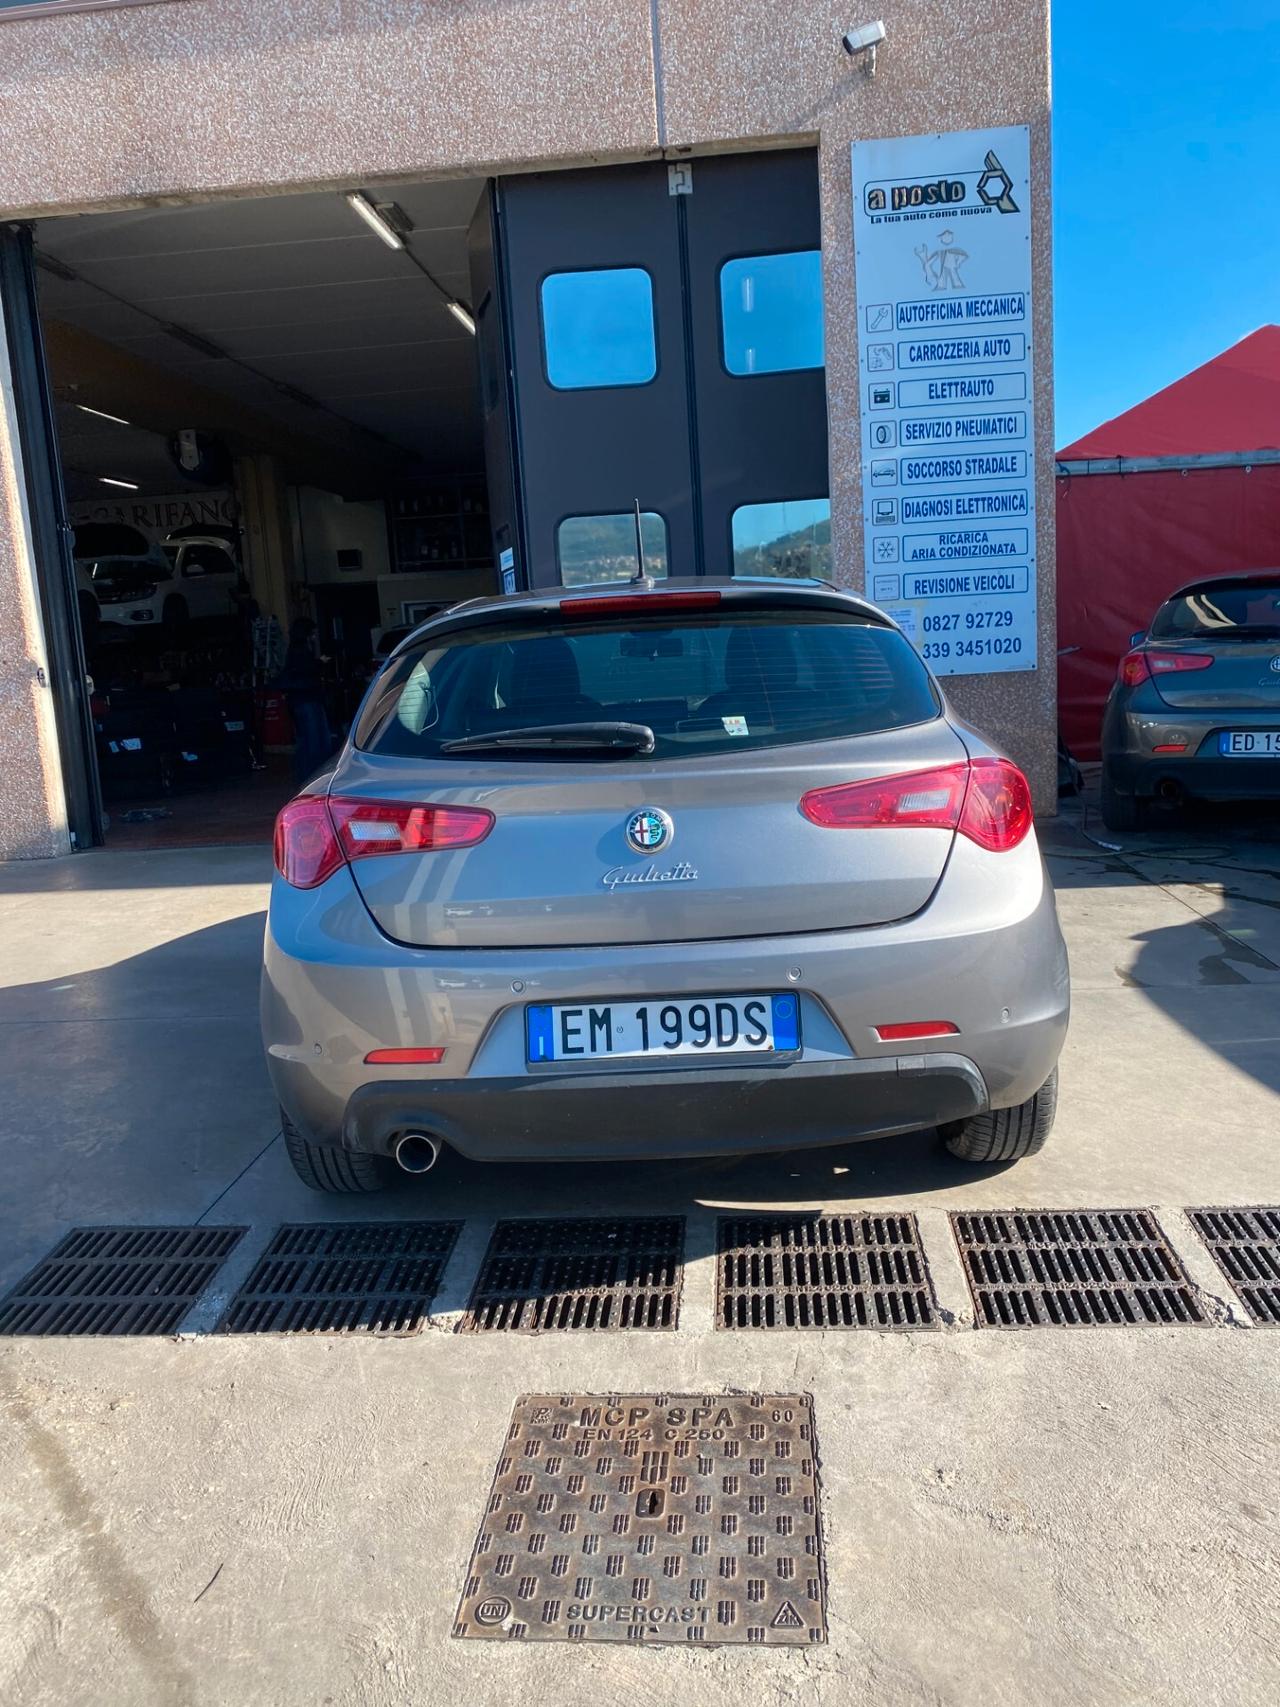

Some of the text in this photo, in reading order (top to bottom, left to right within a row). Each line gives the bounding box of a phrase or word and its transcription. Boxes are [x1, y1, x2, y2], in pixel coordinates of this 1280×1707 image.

[868, 180, 966, 211] a posto
[871, 207, 992, 224] La tua auto come nuova
[899, 297, 1024, 323] AUTOFFICINA MECCANICA
[909, 338, 1011, 362] CARROZZERIA AUTO
[928, 379, 994, 400] ELETTRAUTO
[905, 416, 1017, 440] SERVIZIO PNEUMATICI
[907, 456, 1017, 479] SOCCORSO STRADALE
[904, 494, 1026, 518] DIAGNOSI ELETTRONICA
[939, 532, 989, 545] RICARICA
[911, 543, 1017, 560] ARIA CONDIZIONATA
[914, 577, 970, 596] REVISIONE
[973, 574, 1015, 592] VEICOLI
[923, 614, 960, 632] 0827
[965, 610, 1013, 629] 92729
[922, 637, 1022, 659] 339 3451020
[1232, 733, 1255, 751] ED
[561, 1001, 768, 1054] EM 199DS
[580, 1407, 734, 1427] MCP SPA
[772, 1409, 793, 1423] 60
[583, 1428, 611, 1440] EN
[618, 1428, 653, 1440] 124
[664, 1428, 678, 1440] C
[566, 1603, 712, 1623] SUPERCAST
